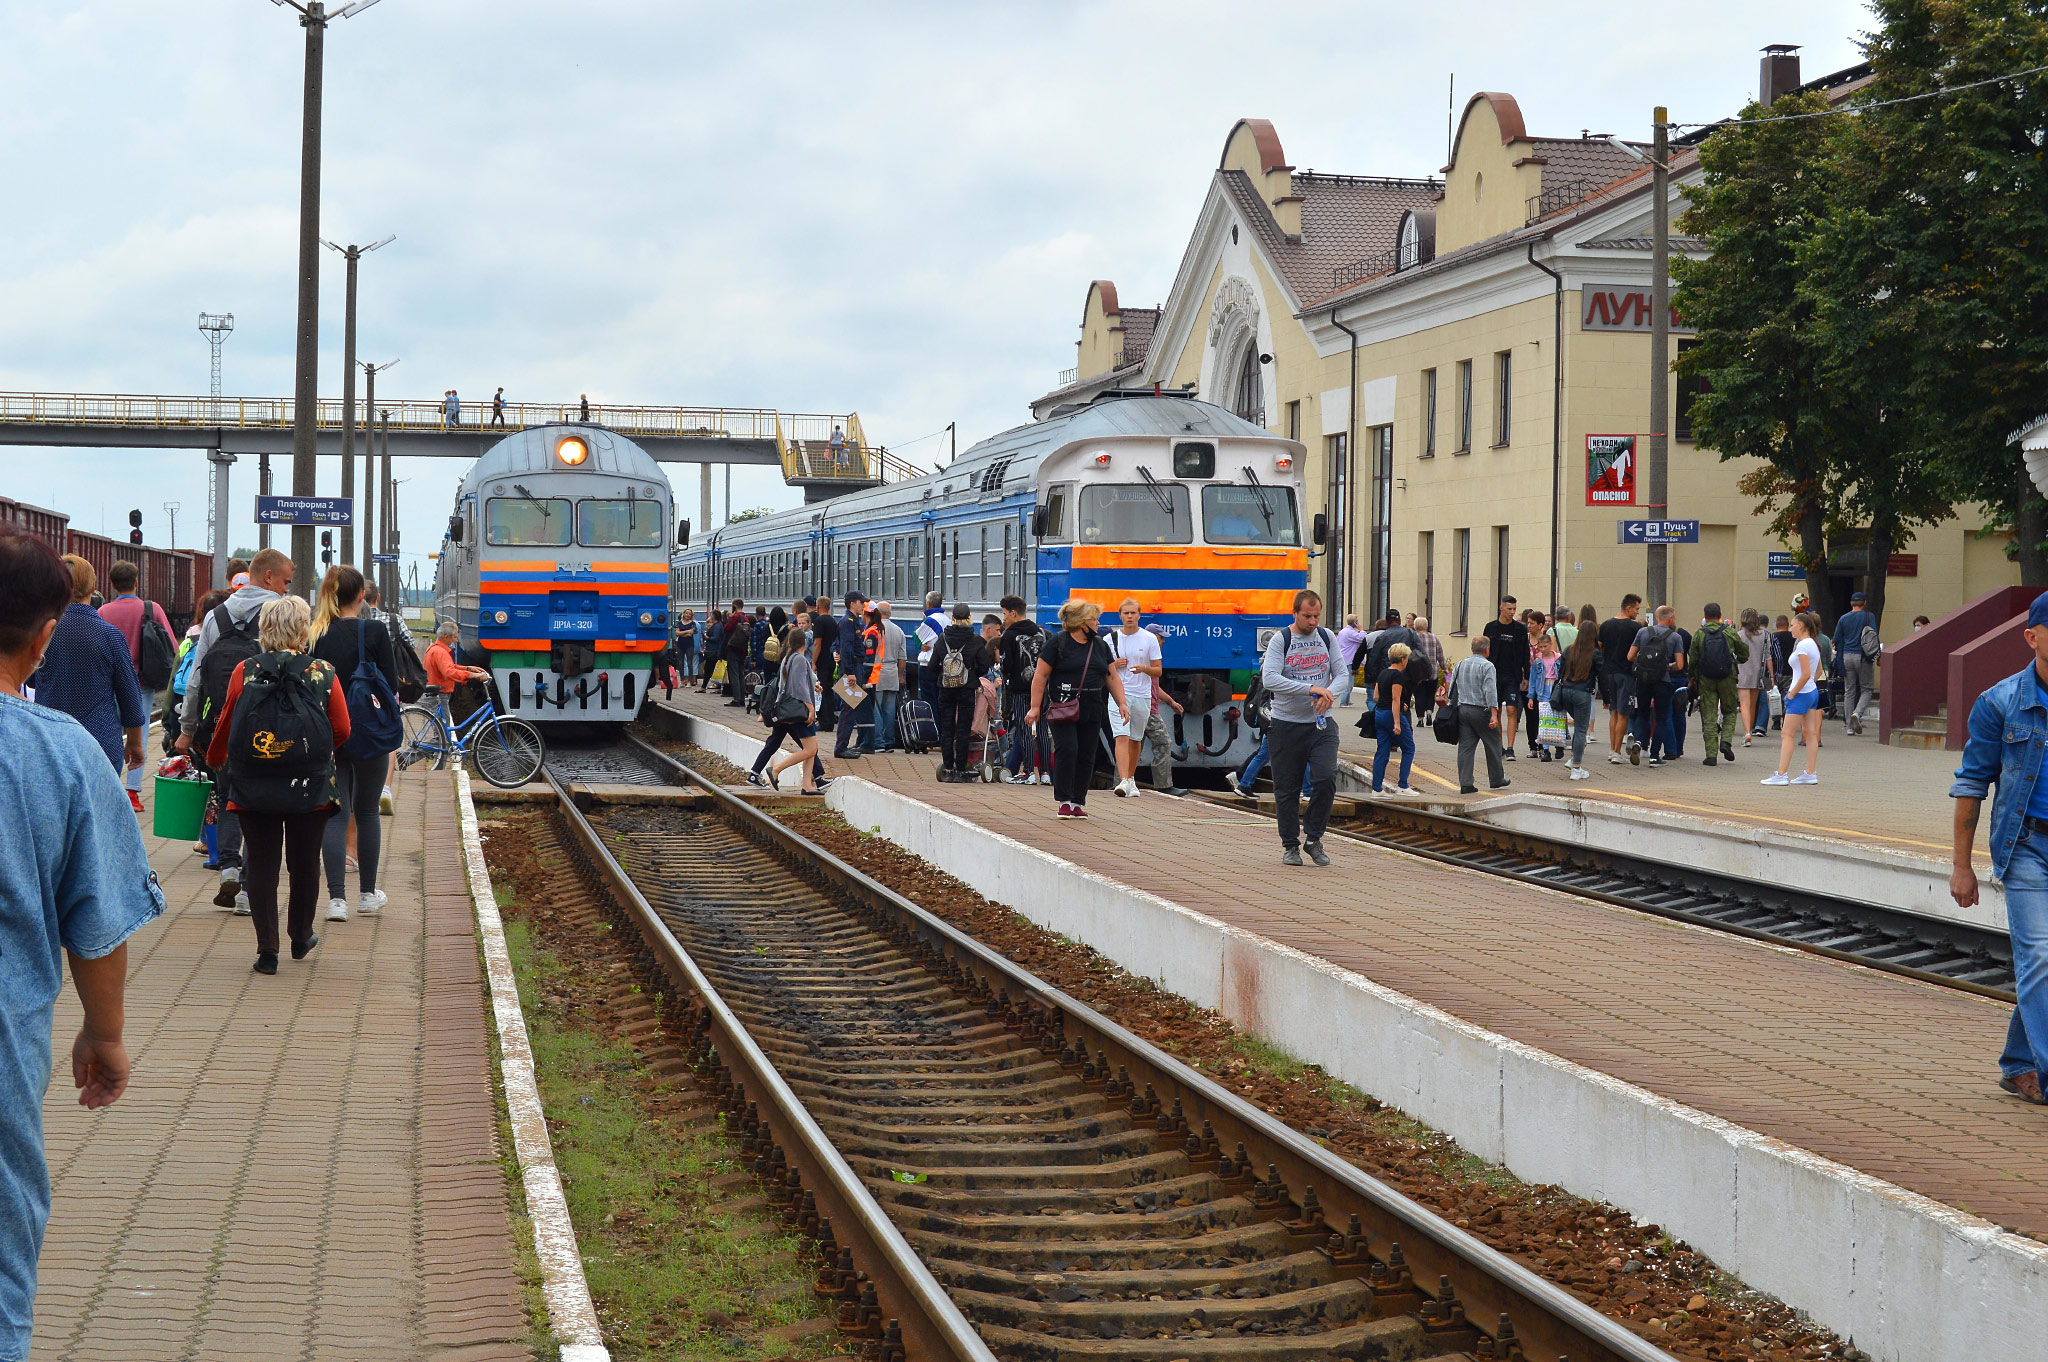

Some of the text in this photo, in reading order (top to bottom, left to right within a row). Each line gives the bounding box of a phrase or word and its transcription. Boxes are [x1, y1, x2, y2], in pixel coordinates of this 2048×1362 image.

[1585, 292, 1685, 326] ЛУН
[1592, 491, 1629, 501] ОПАСНО!
[277, 499, 334, 510] Платформа 2
[1663, 522, 1693, 531] Пуць 1
[1206, 626, 1233, 638] 193
